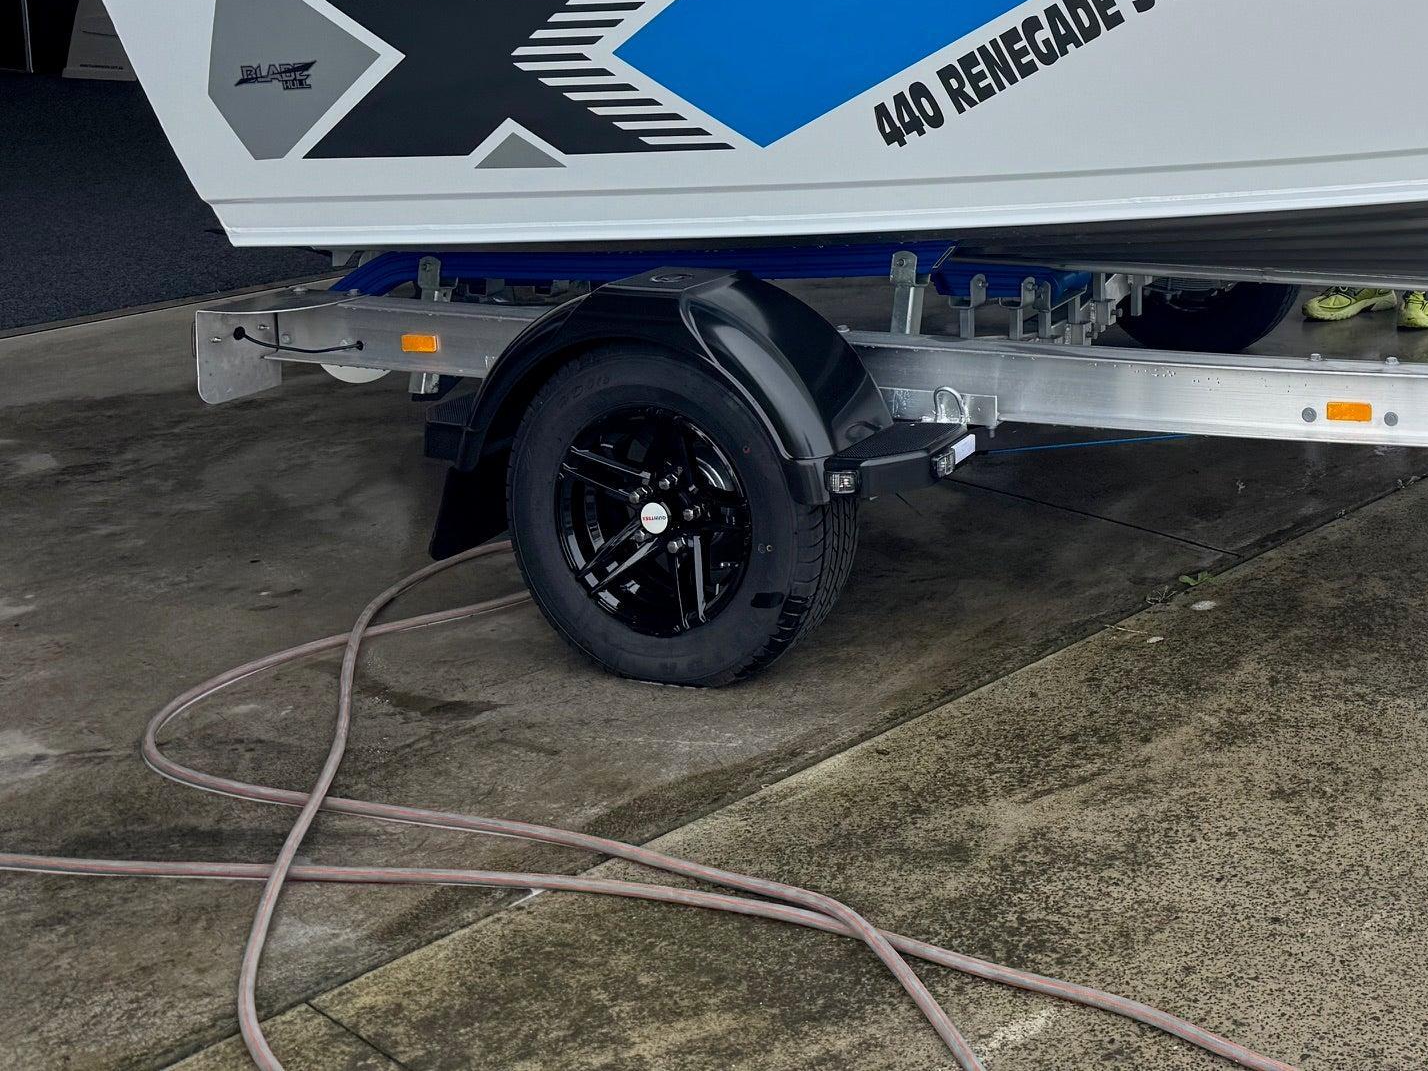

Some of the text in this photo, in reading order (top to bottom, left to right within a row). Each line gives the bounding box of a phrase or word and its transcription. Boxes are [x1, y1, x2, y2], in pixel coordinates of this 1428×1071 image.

[235, 61, 317, 89] BLADE
[282, 81, 312, 90] HULL
[873, 81, 945, 148] 440
